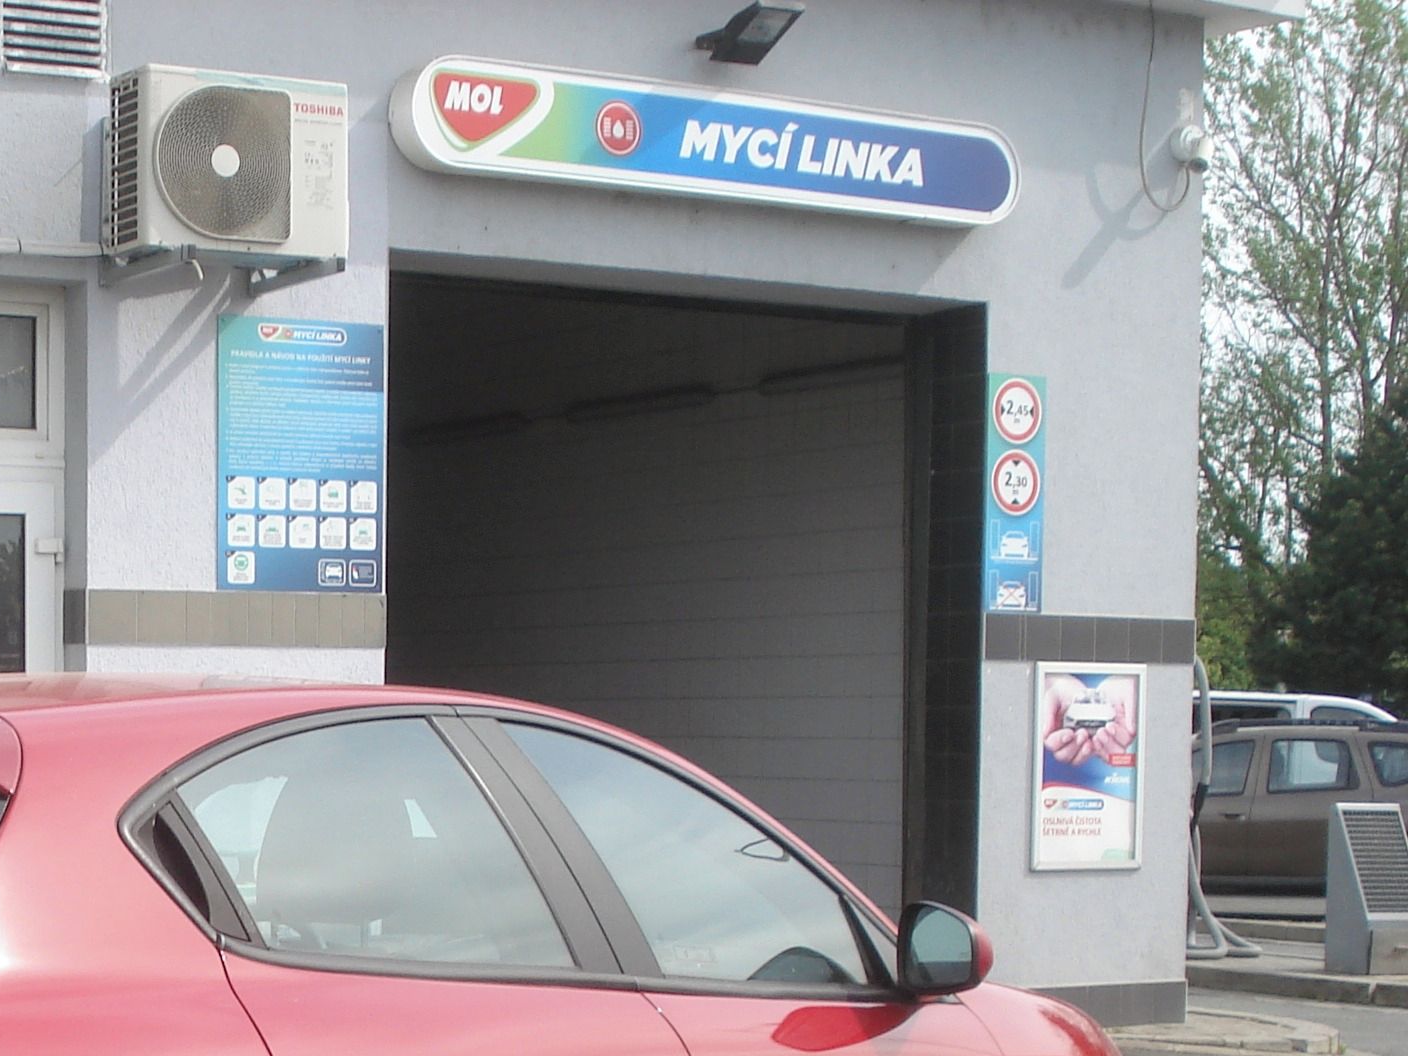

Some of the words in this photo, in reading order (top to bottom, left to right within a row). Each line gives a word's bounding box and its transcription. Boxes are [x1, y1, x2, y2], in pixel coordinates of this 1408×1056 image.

[443, 80, 503, 116] MOL
[293, 102, 344, 117] TOSHIBA
[679, 119, 797, 171] MYCÍ
[798, 138, 925, 187] LINKA
[316, 331, 343, 342] LINKA
[1006, 400, 1029, 417] 2,45
[1004, 471, 1028, 489] 2,30
[1071, 828, 1076, 836] A
